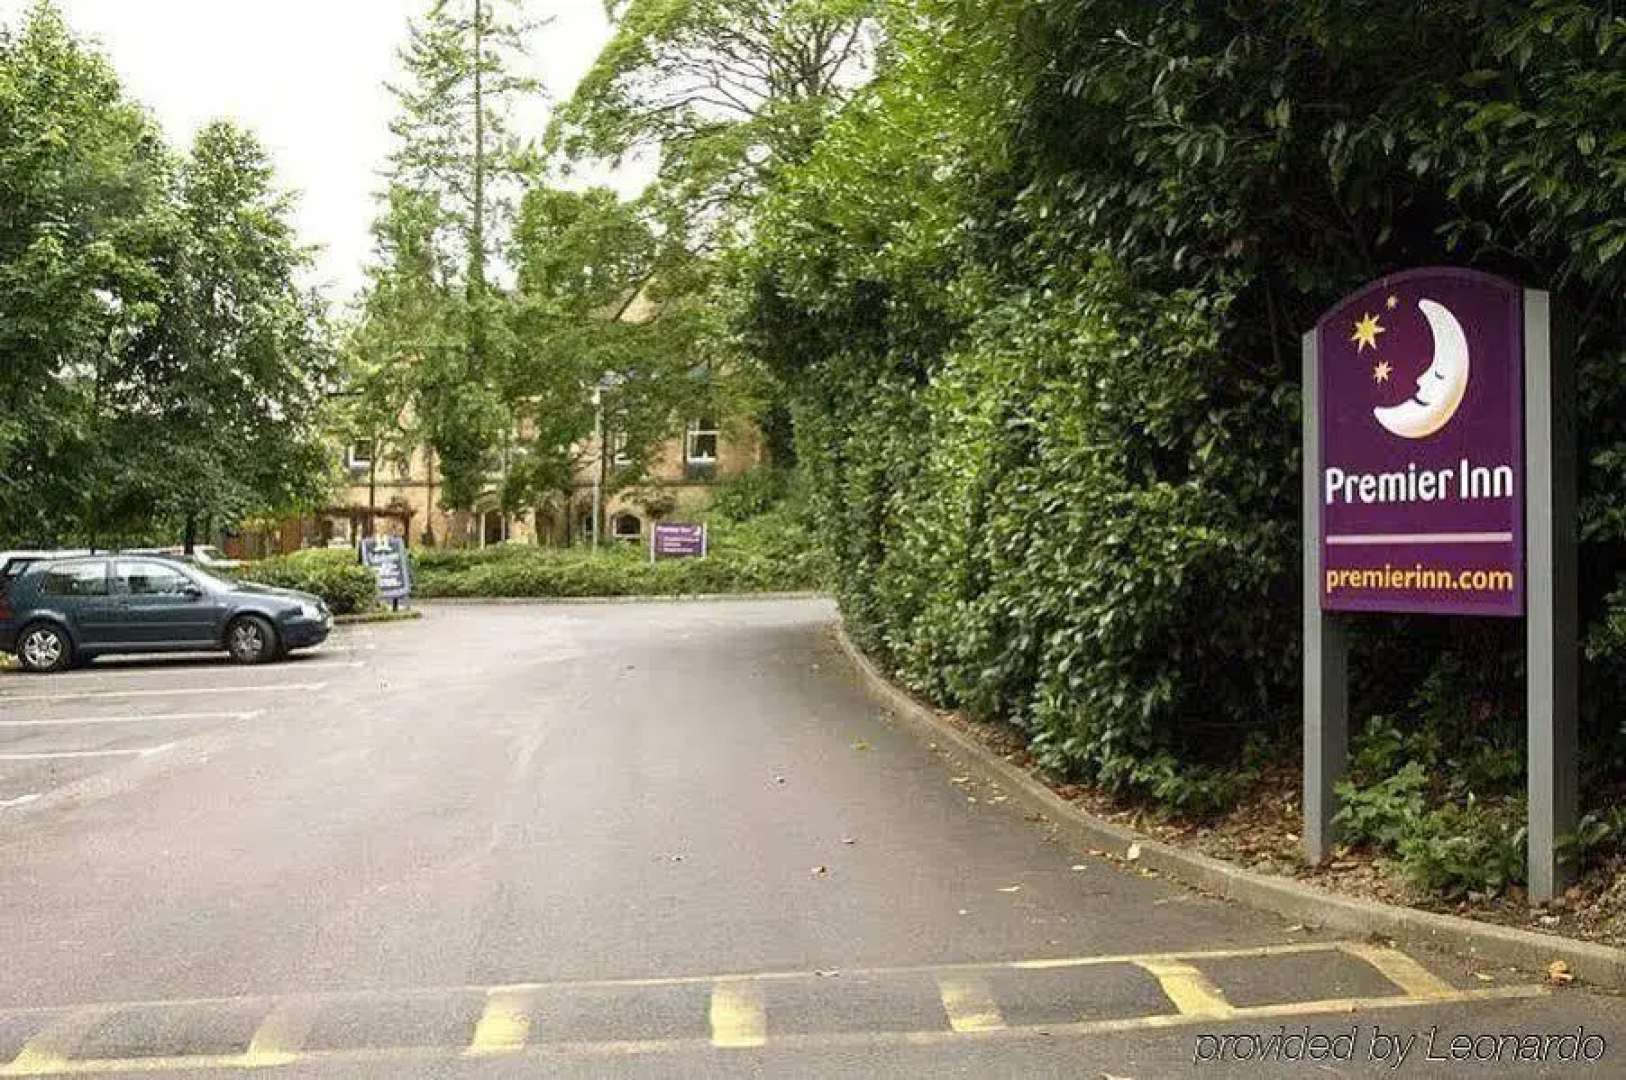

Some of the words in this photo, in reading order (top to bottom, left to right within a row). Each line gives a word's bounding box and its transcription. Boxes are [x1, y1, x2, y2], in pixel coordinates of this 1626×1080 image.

[1325, 462, 1454, 504] Premier
[1459, 458, 1514, 499] Inn
[1326, 562, 1514, 594] premierinn.com
